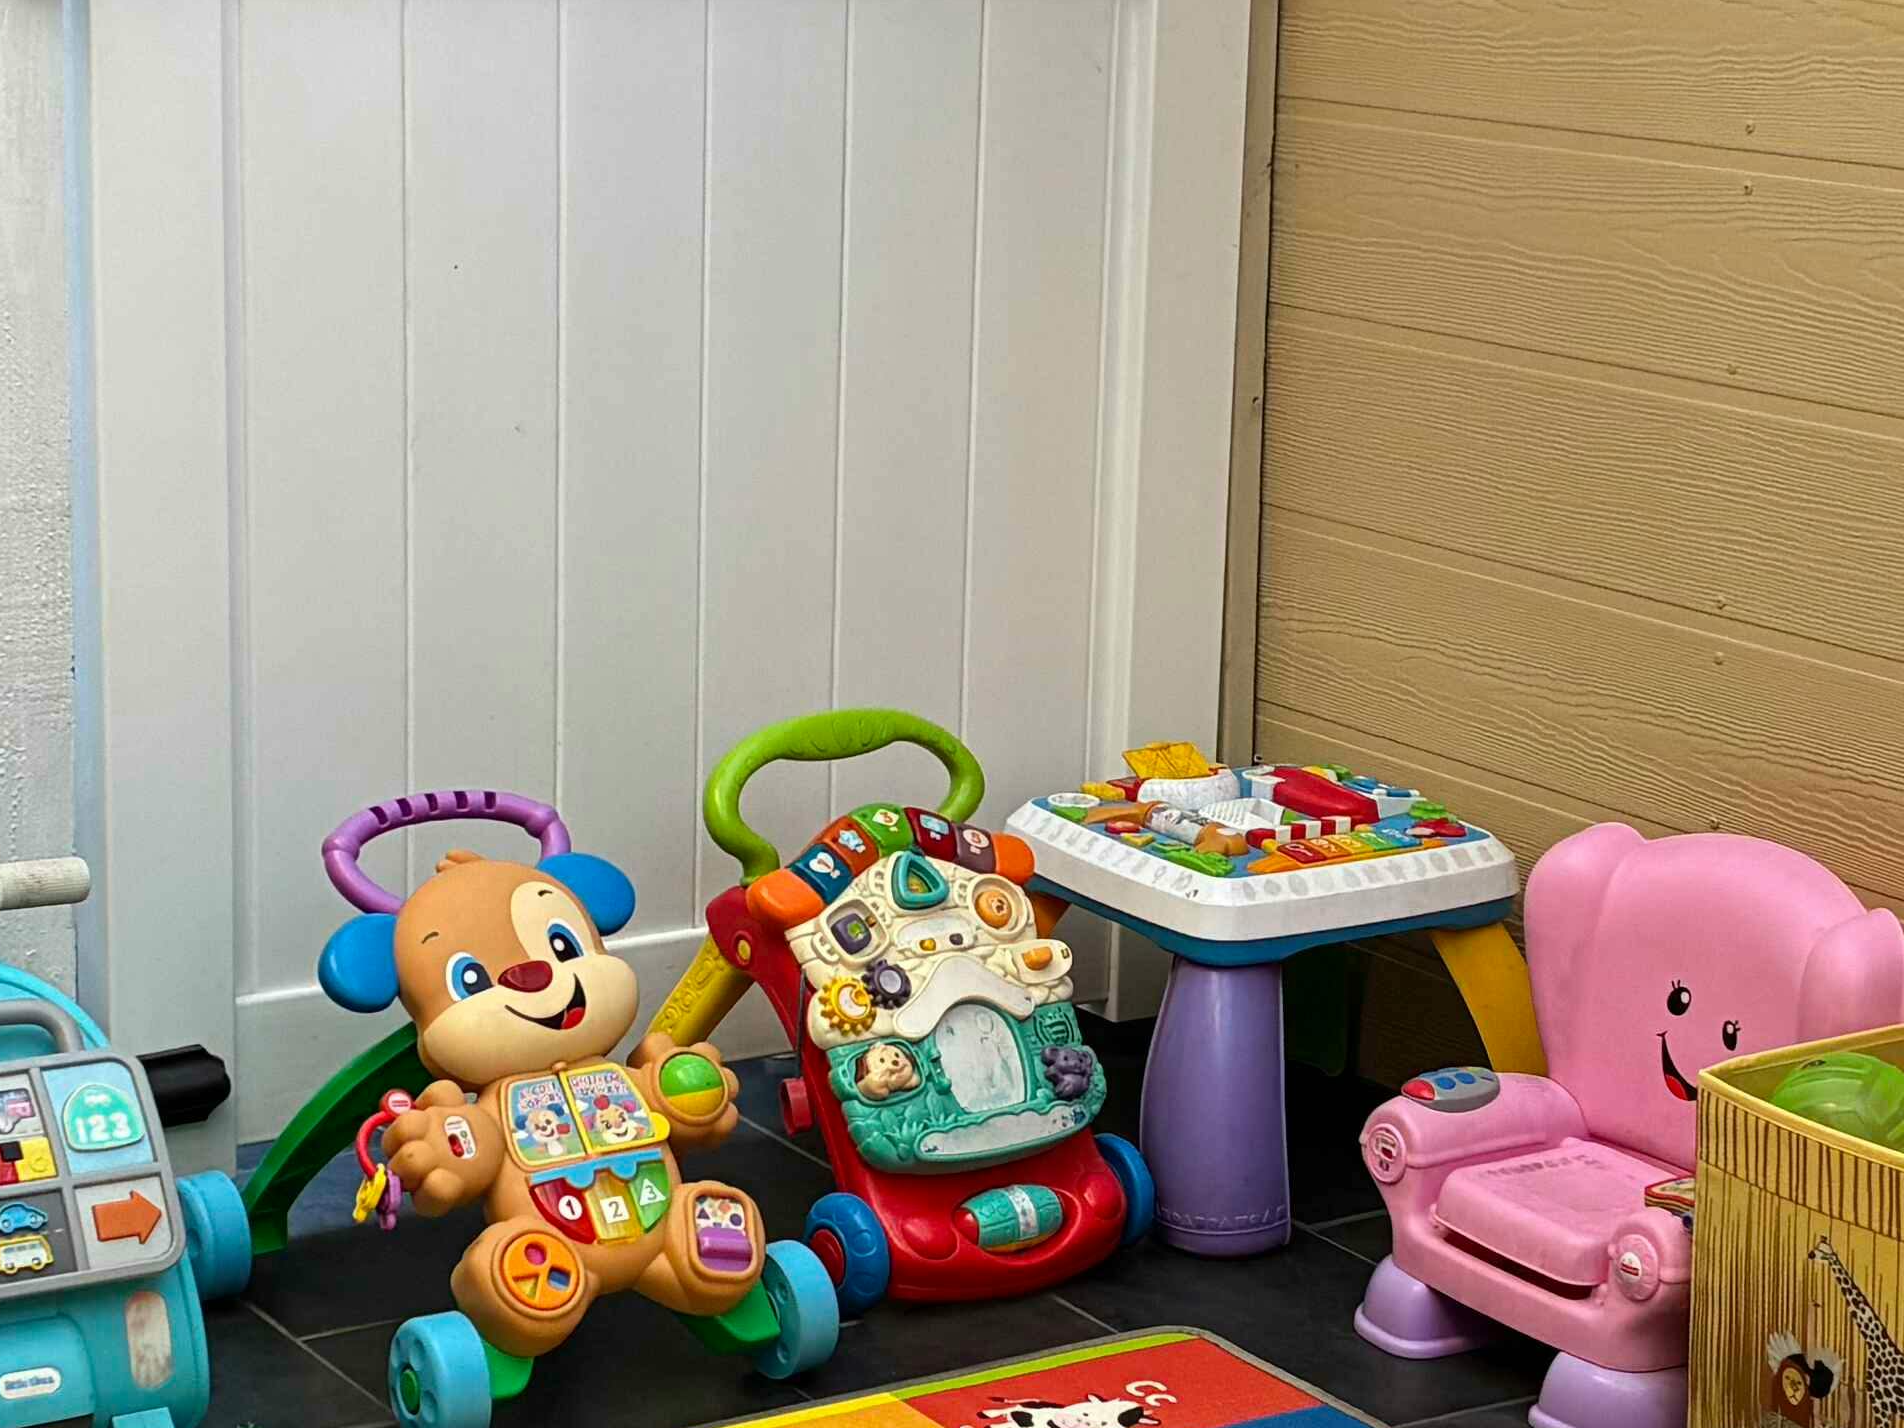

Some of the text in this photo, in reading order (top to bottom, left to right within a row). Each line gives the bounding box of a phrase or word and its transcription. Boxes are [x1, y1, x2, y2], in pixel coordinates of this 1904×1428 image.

[645, 1184, 657, 1201] 3
[565, 1198, 576, 1216] 1
[608, 1200, 623, 1219] 2
[1124, 1379, 1178, 1409] Cc
